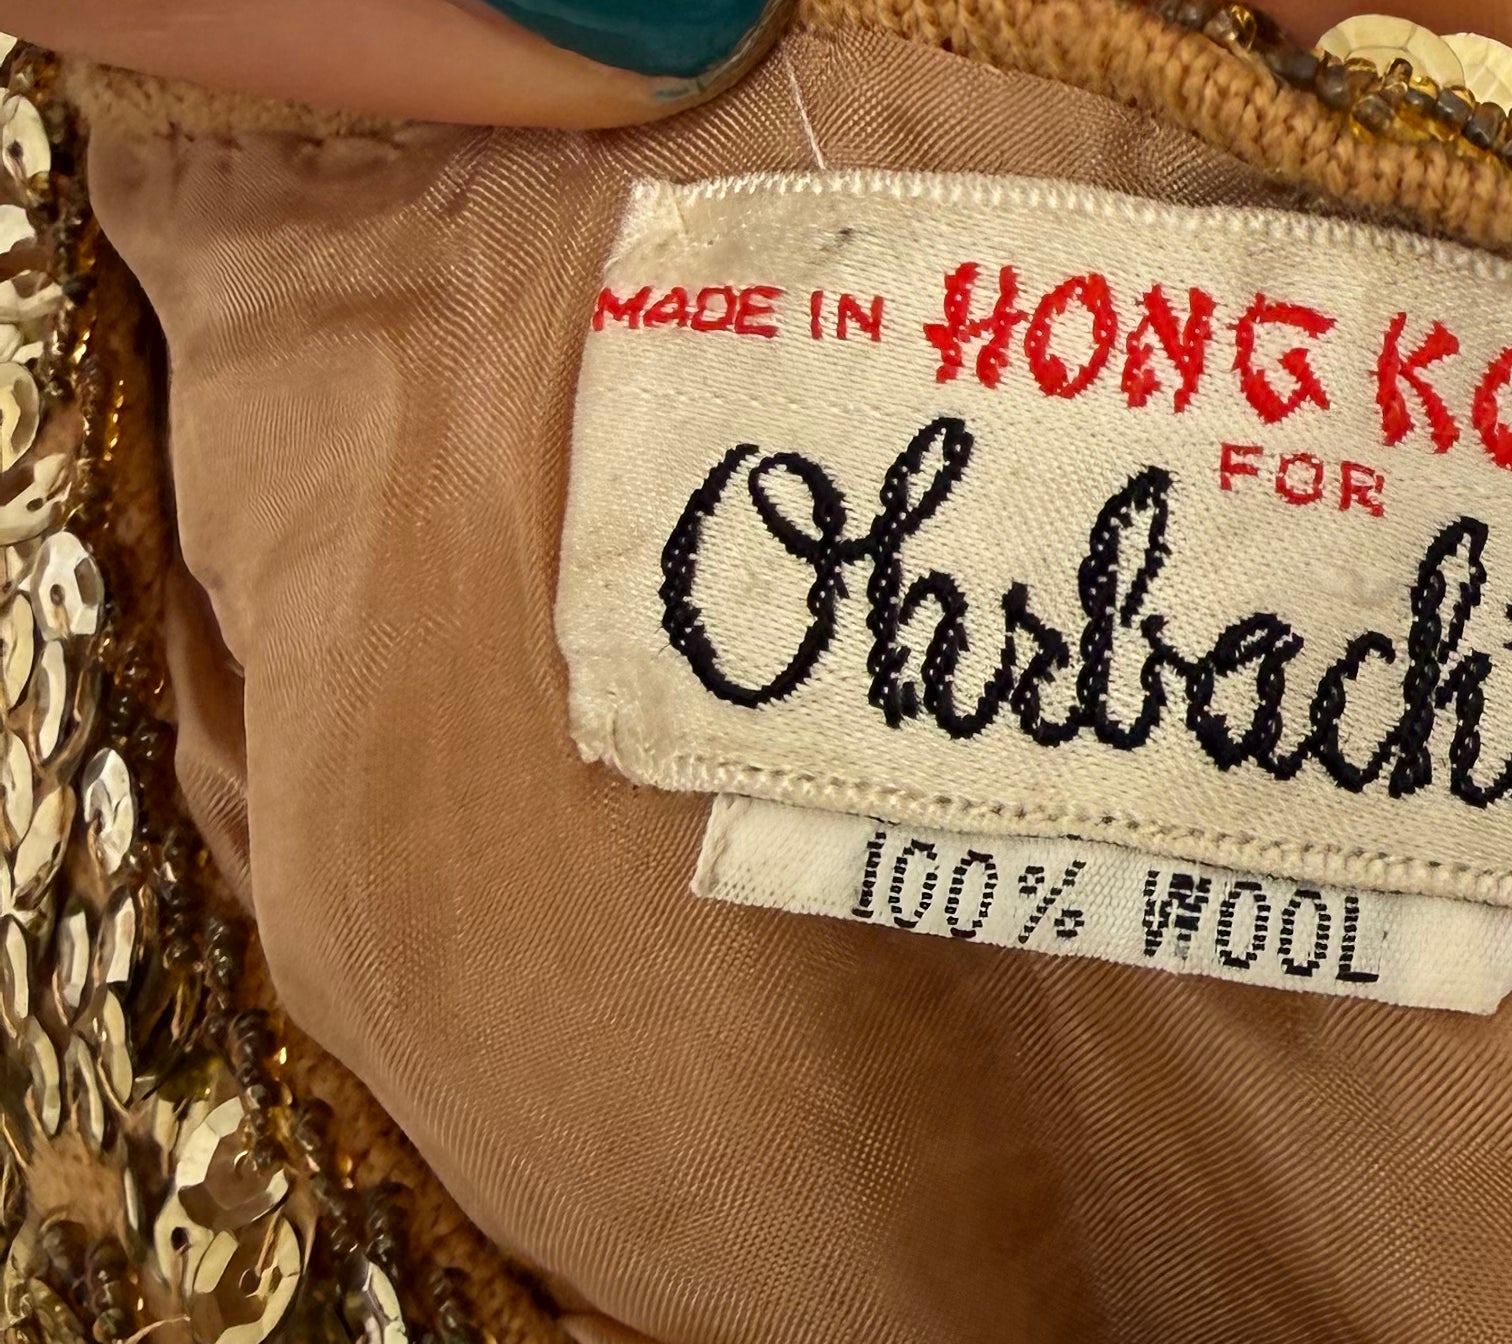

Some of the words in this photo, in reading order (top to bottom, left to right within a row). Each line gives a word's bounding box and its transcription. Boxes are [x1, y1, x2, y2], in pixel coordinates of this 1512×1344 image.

[592, 285, 783, 338] MADE
[810, 290, 884, 342] IN
[923, 261, 1336, 424] HONG
[1220, 442, 1385, 516] FOR
[1142, 869, 1380, 983] WOOL
